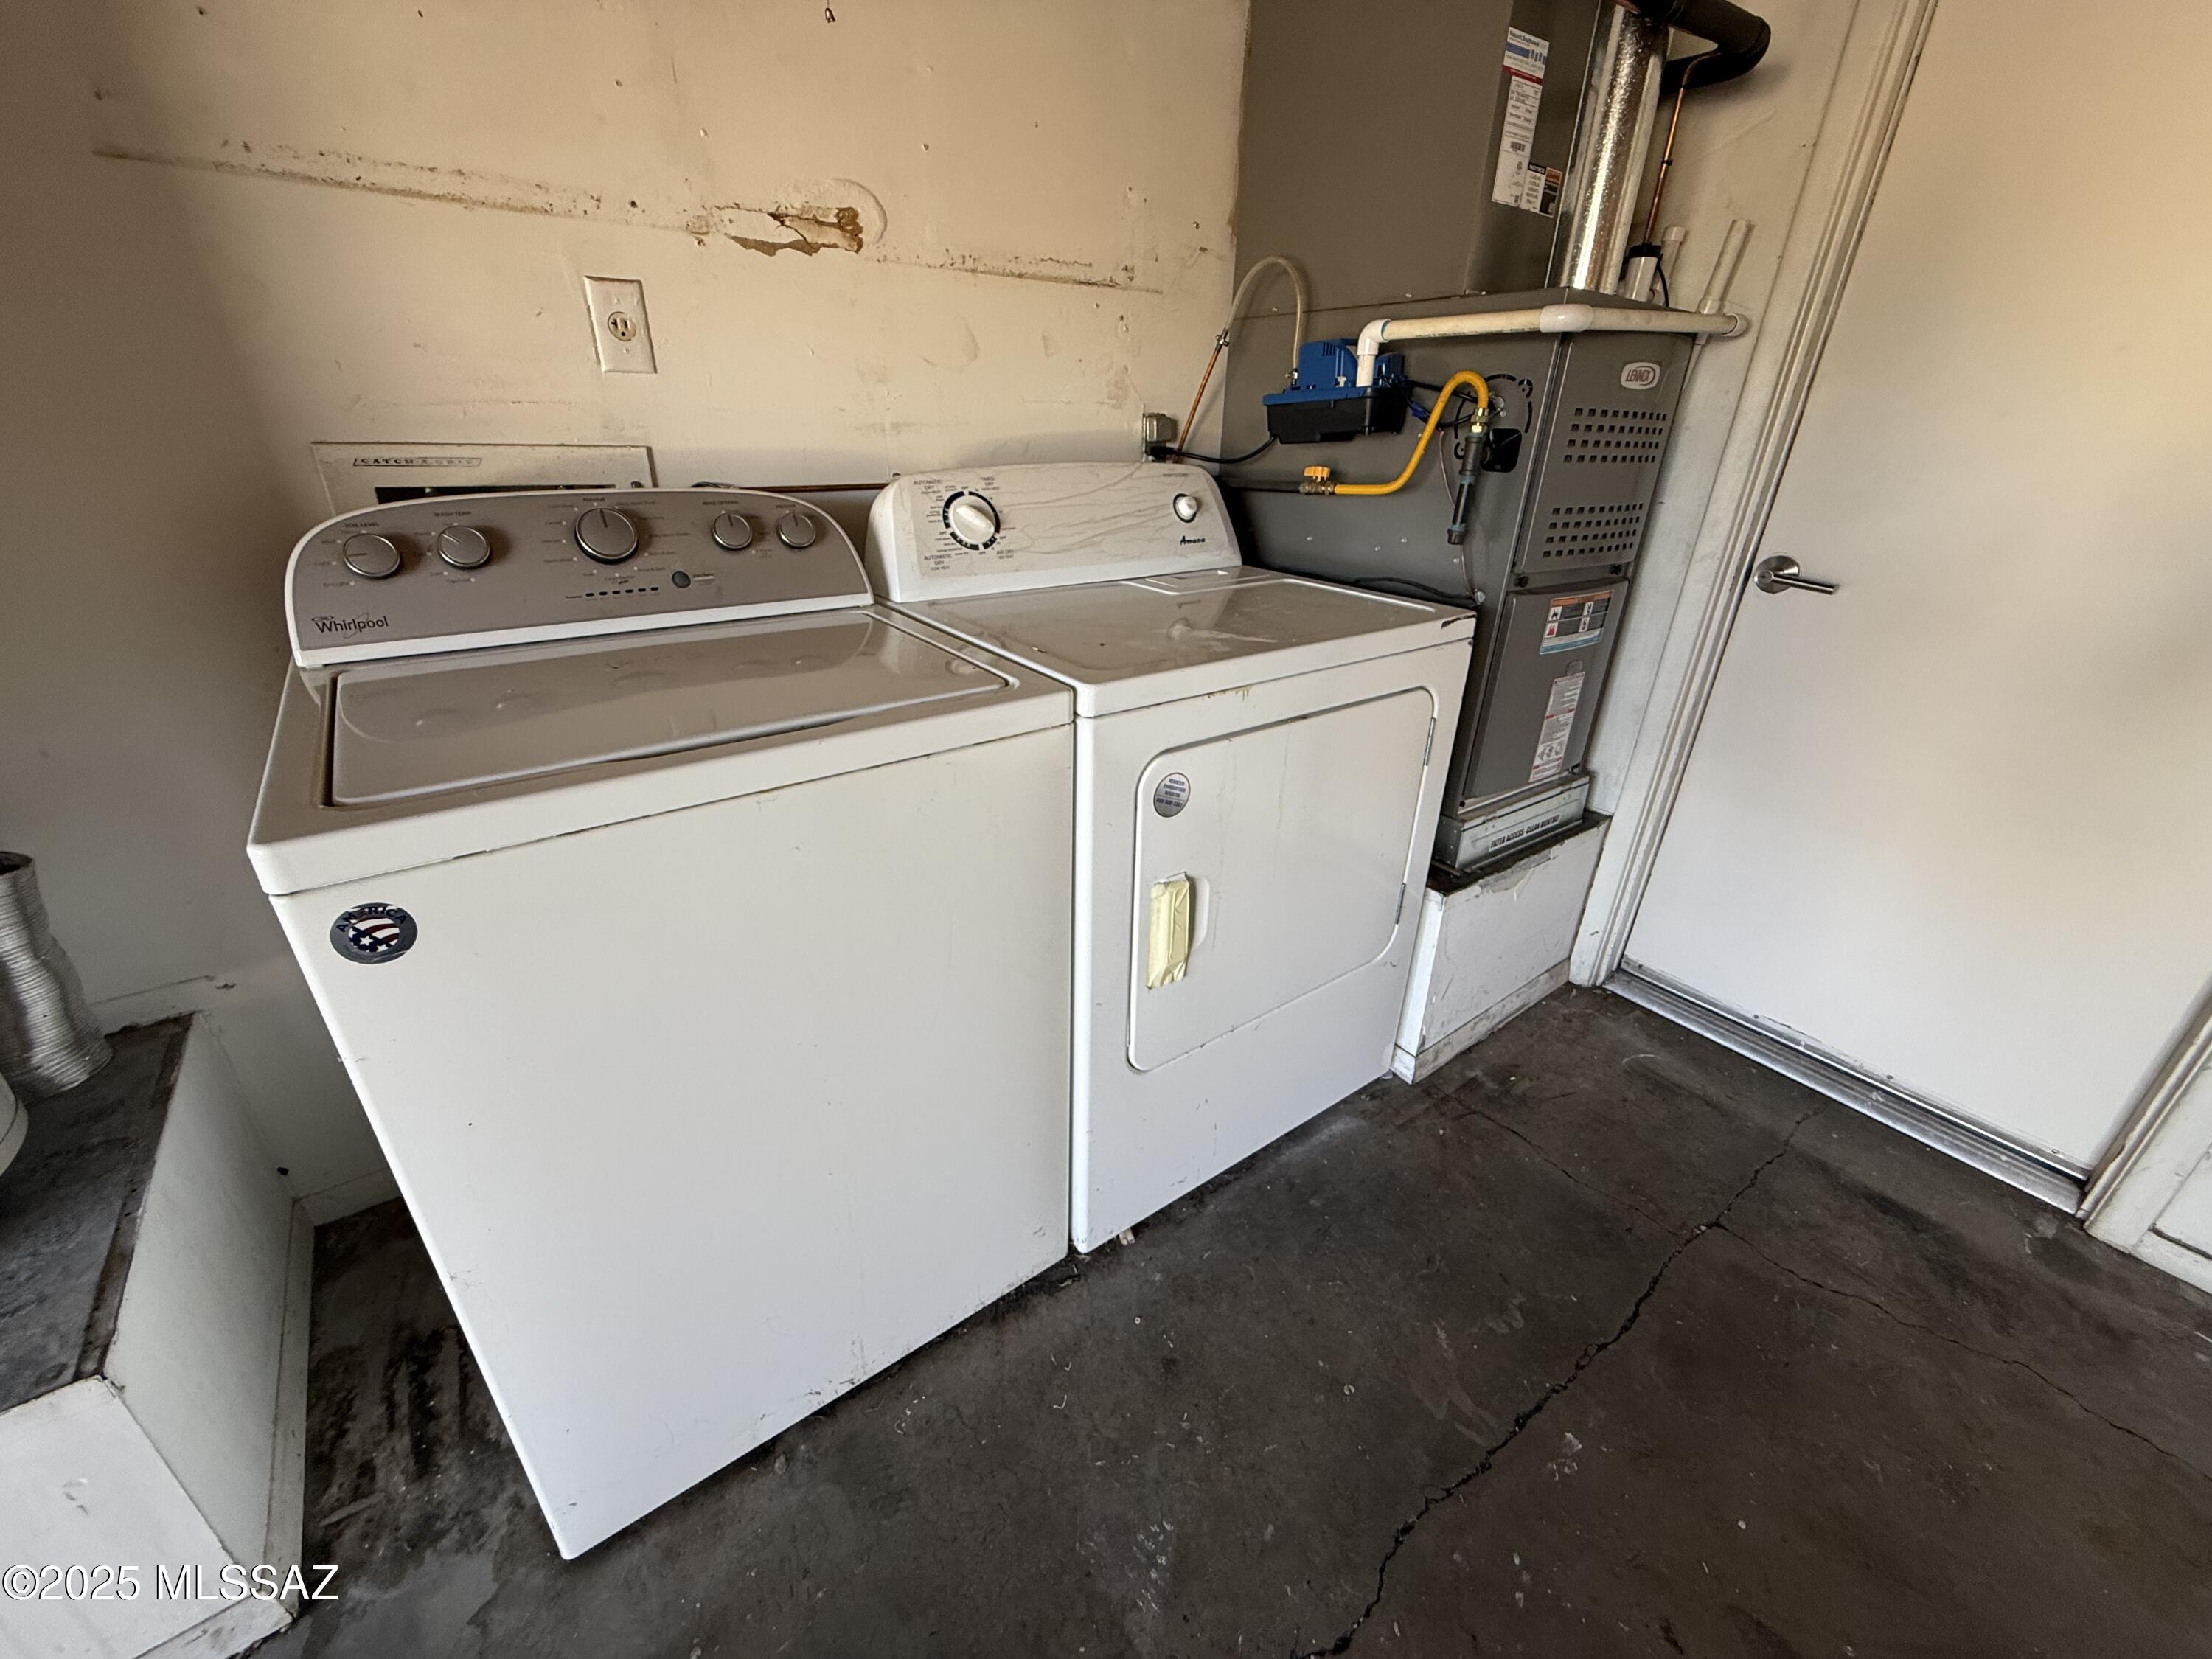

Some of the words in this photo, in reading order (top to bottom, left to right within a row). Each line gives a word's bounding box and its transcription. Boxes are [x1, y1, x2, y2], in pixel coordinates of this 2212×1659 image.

[1529, 164, 1545, 174] NOTICE
[1625, 369, 1651, 382] LENNOX
[1180, 535, 1205, 545] Amana
[316, 616, 389, 633] Whirlpool
[1491, 836, 1506, 848] FILTER
